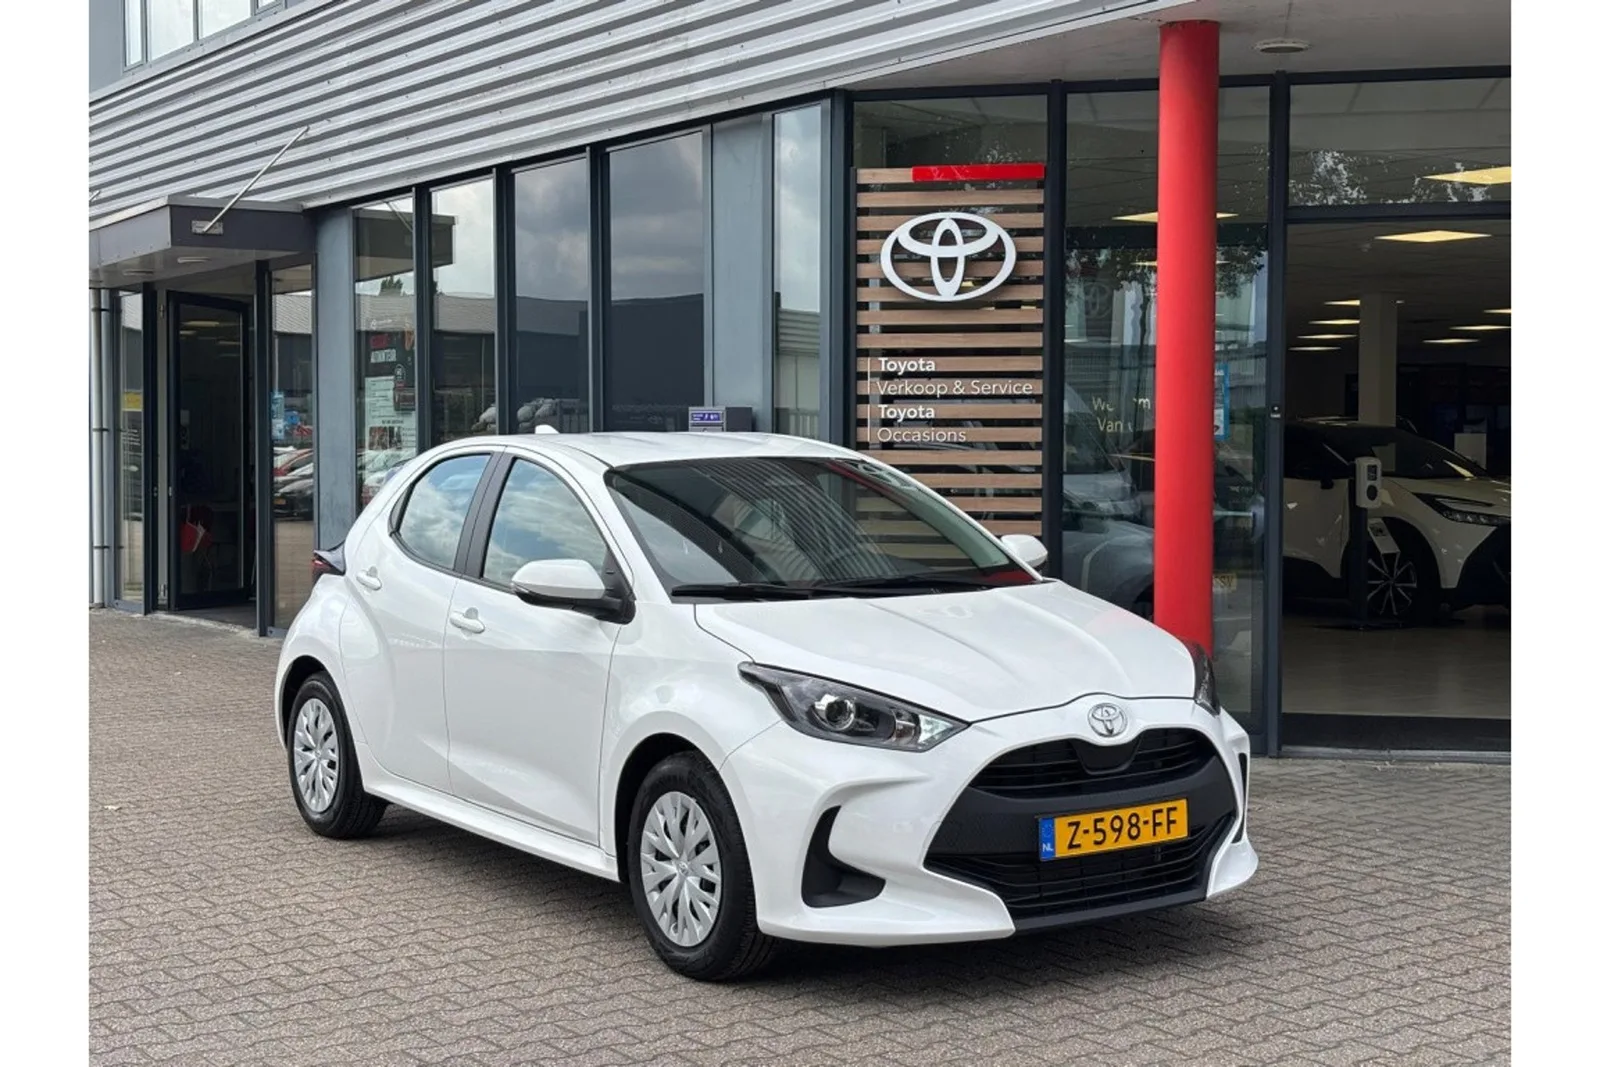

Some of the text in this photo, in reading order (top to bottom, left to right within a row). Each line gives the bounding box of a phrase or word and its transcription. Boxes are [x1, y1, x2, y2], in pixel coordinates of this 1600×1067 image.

[878, 357, 936, 375] Toyota
[876, 380, 1033, 398] Verkoop & Service
[878, 404, 936, 422] Toyota
[1096, 416, 1123, 433] Van
[876, 427, 967, 442] Occasions
[1067, 806, 1177, 850] Z-598-FF
[1042, 842, 1054, 852] NL
